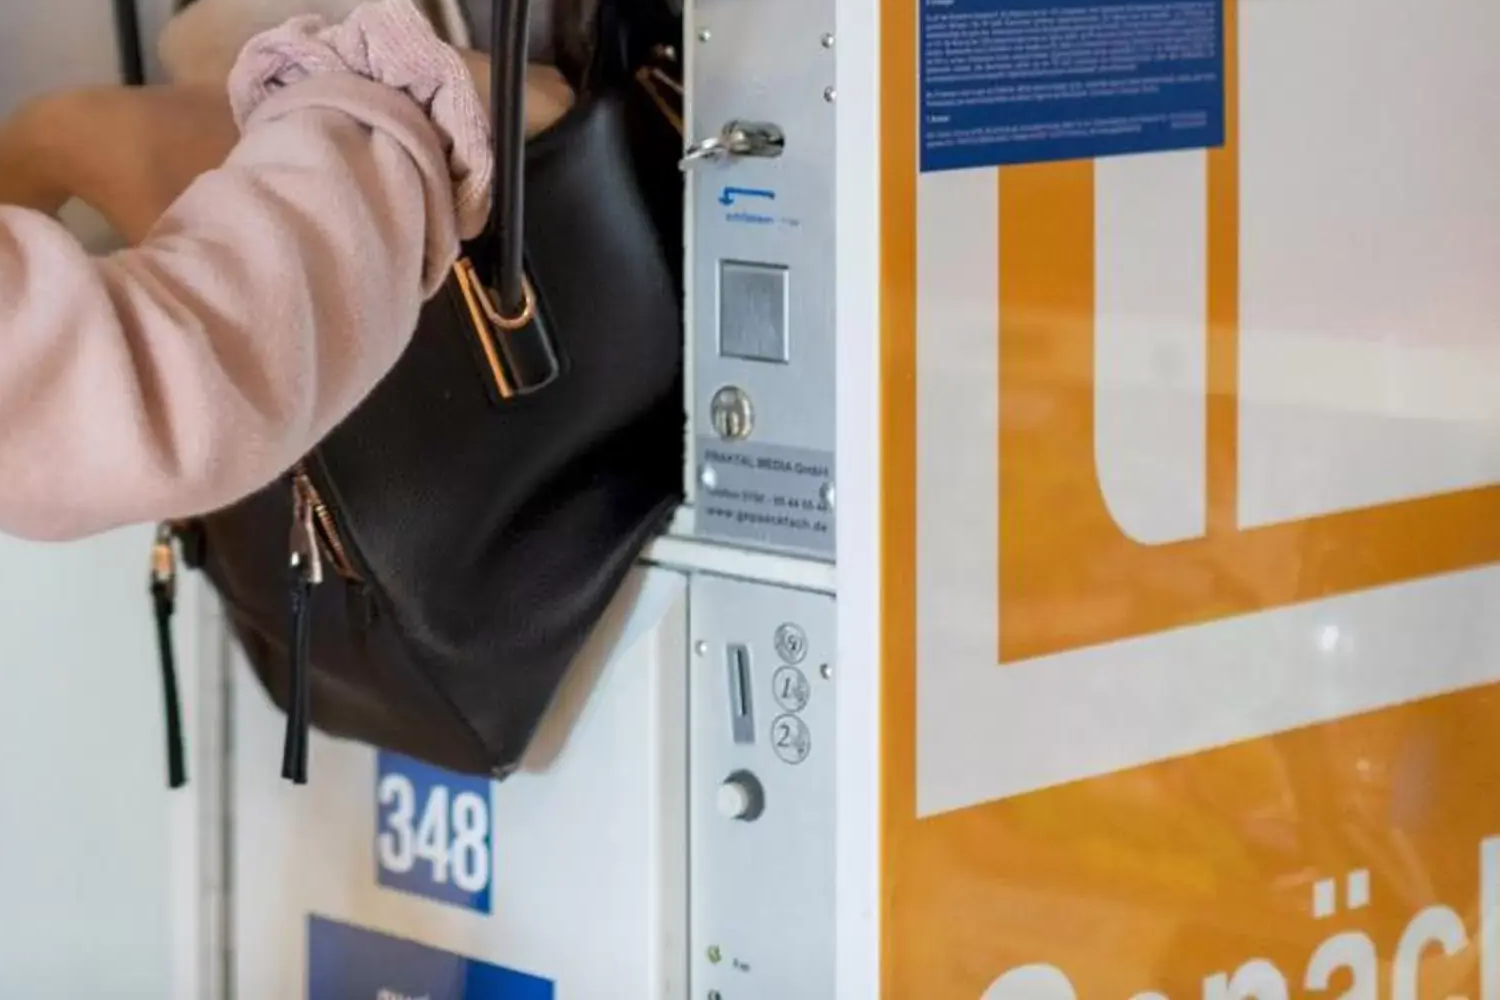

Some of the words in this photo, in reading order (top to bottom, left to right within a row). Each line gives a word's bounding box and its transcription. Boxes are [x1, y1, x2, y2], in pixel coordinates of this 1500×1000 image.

[704, 451, 755, 470] FRAKTAL
[757, 457, 793, 473] MEDIA
[795, 460, 829, 477] GmbH
[379, 772, 489, 892] 348
